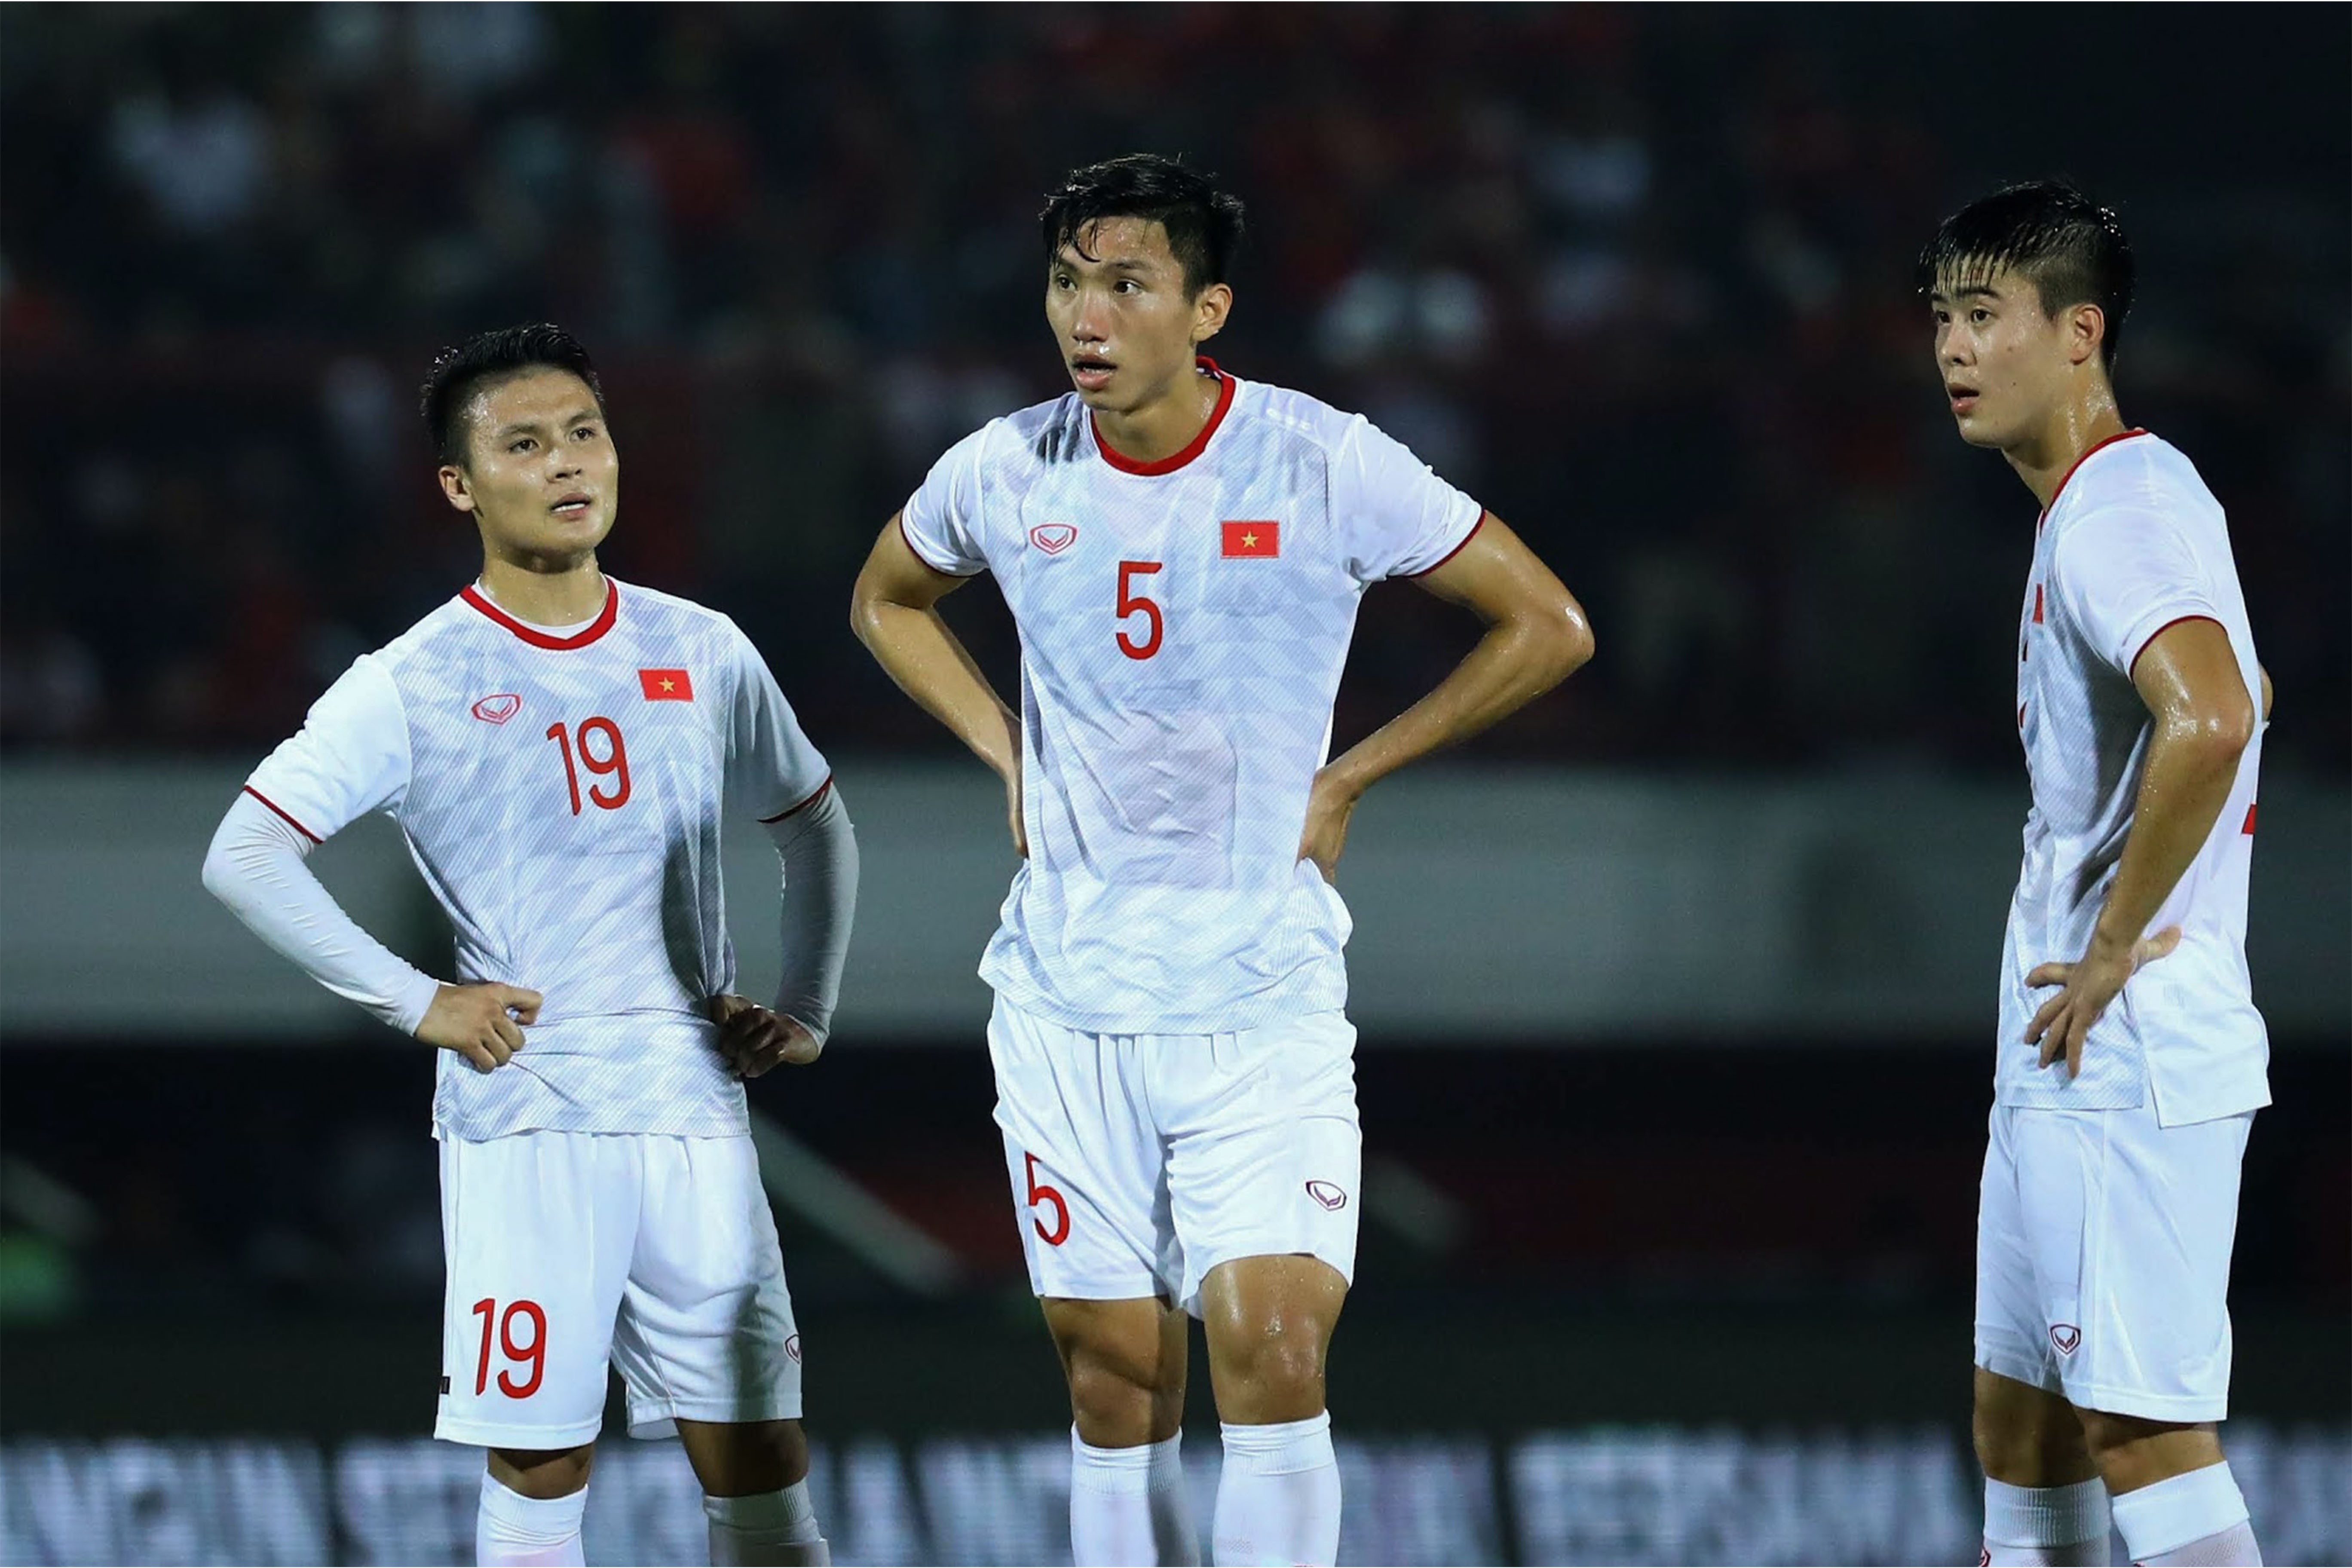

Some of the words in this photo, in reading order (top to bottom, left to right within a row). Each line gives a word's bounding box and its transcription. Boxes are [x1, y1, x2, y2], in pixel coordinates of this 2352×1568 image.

[1116, 560, 1163, 660] 5
[546, 717, 631, 815] 19
[1025, 1151, 1070, 1246] 5
[473, 1298, 547, 1399] 19
